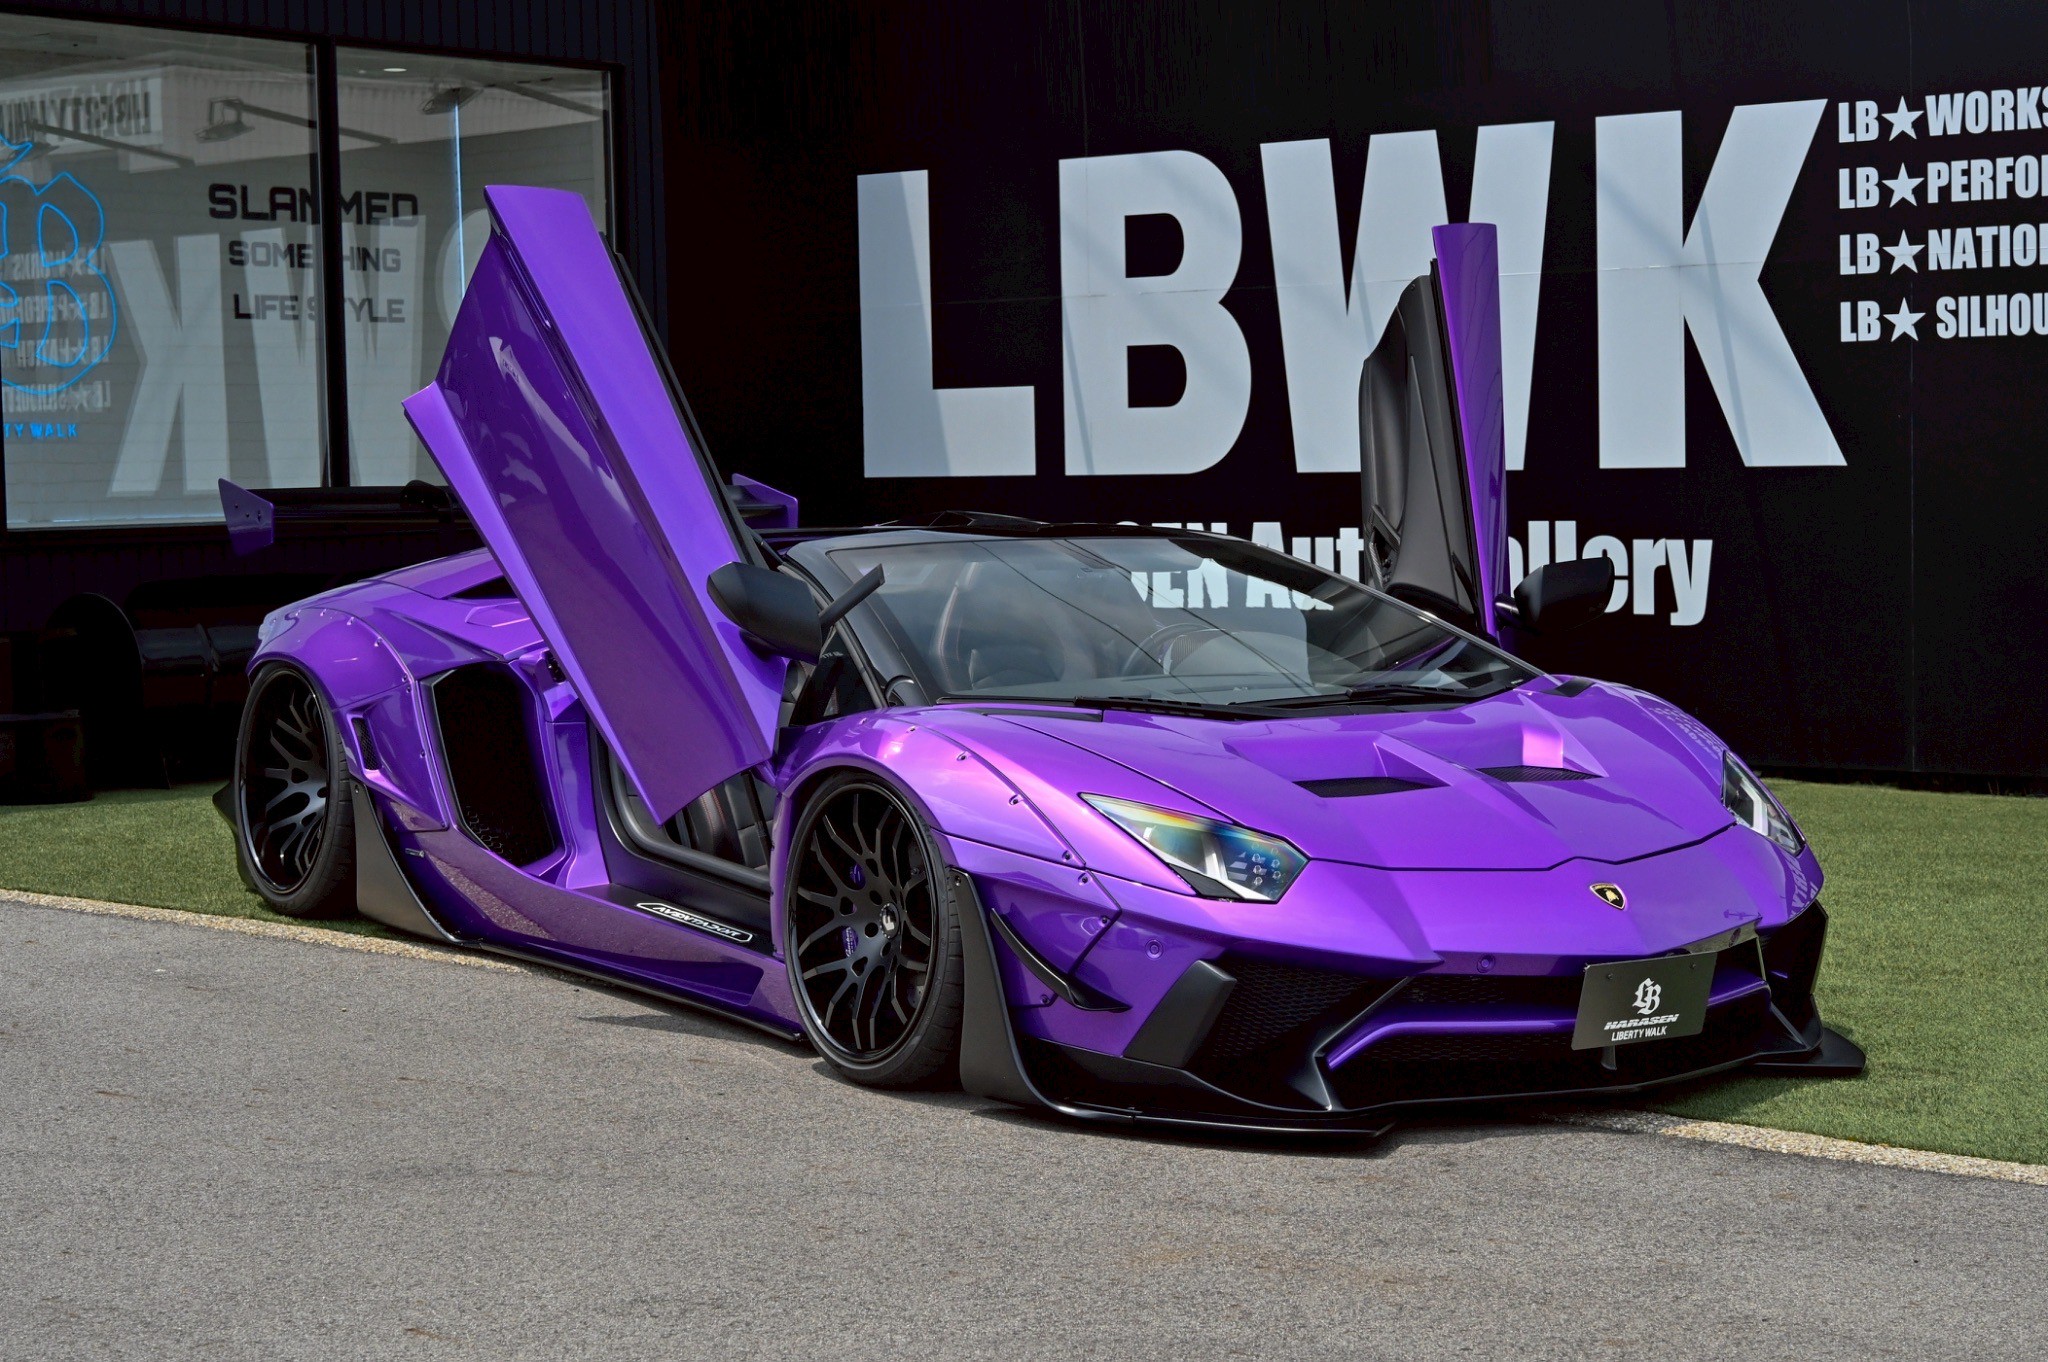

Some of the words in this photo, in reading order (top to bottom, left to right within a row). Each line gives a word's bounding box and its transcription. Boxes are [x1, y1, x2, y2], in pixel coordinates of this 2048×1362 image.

[1925, 86, 2048, 137] WORK
[208, 183, 419, 227] SLAMMED
[228, 240, 402, 273] SOMEHING
[857, 98, 1849, 478] LBWK
[307, 296, 405, 323] SYLE
[1936, 292, 2048, 339] SILHOU
[29, 422, 78, 439] WALK
[1603, 1013, 1680, 1031] HARASEN
[1611, 1028, 1644, 1042] LIBERTY
[1644, 1025, 1668, 1038] WALK
